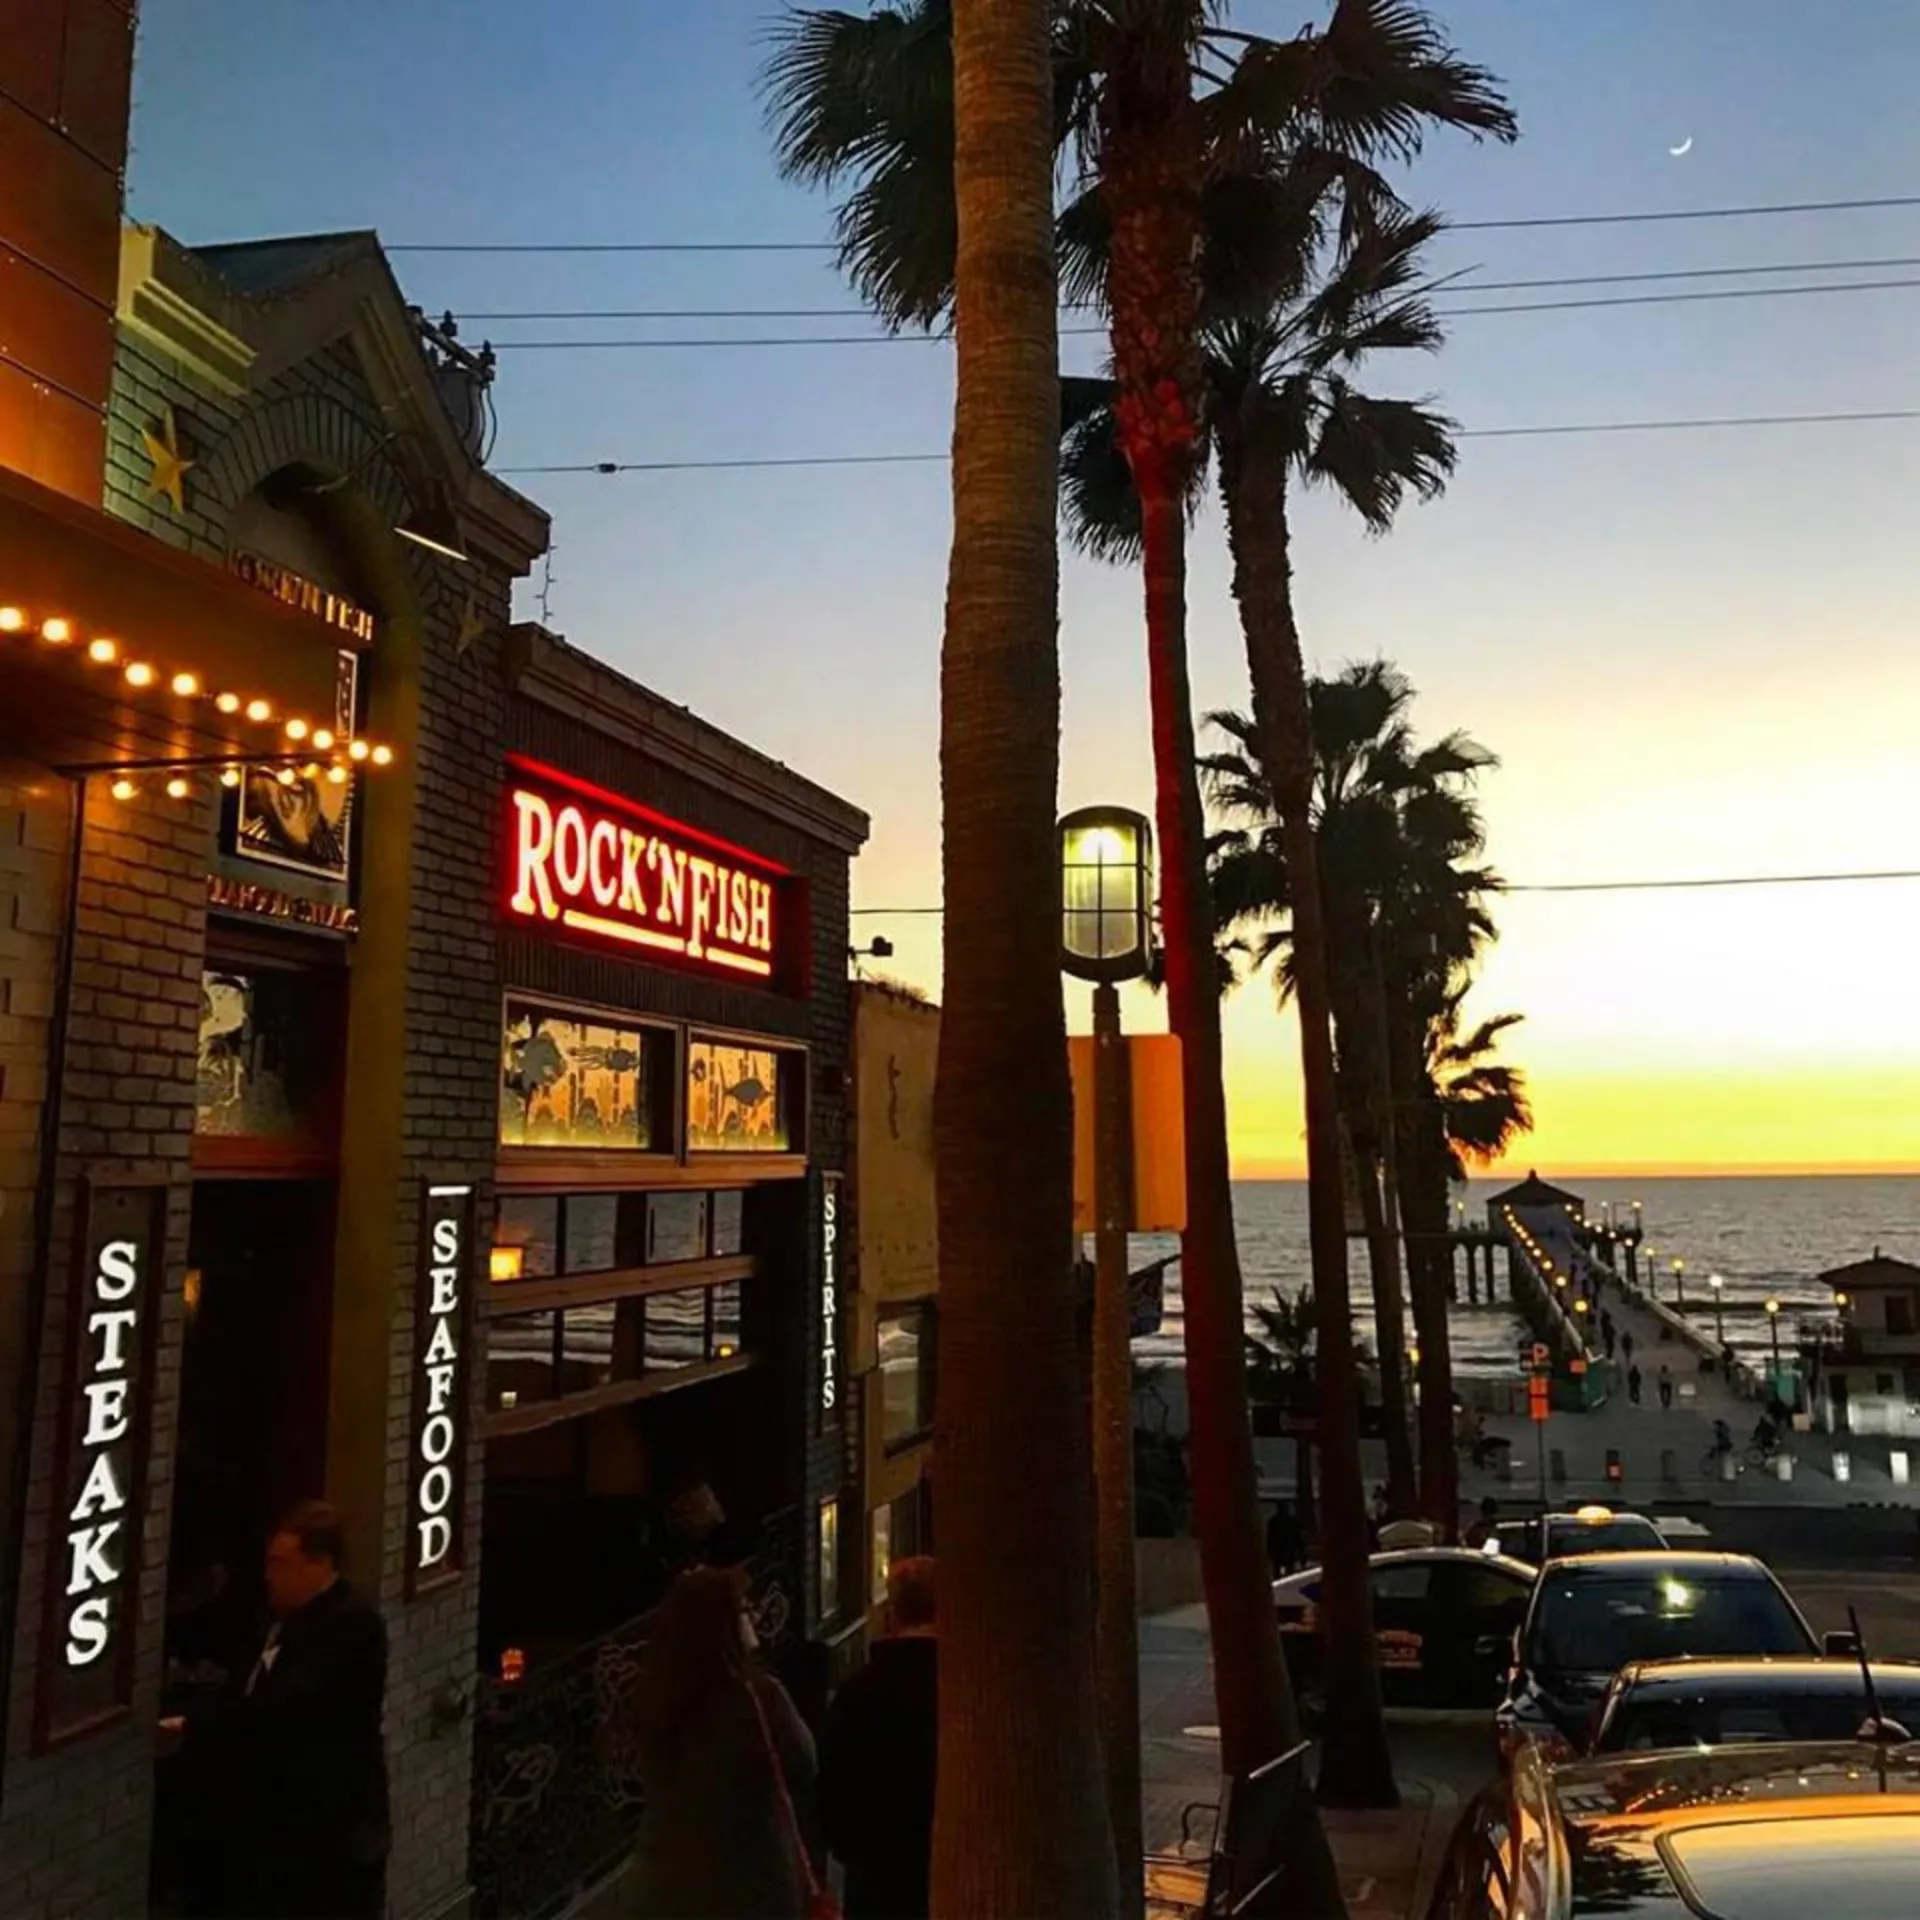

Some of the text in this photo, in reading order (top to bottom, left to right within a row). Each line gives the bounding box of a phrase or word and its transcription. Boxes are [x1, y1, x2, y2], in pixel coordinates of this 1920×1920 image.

[65, 1241, 138, 1666] STEAKS
[417, 1219, 458, 1568] SEAFOOD
[822, 1192, 837, 1409] SPIRITS
